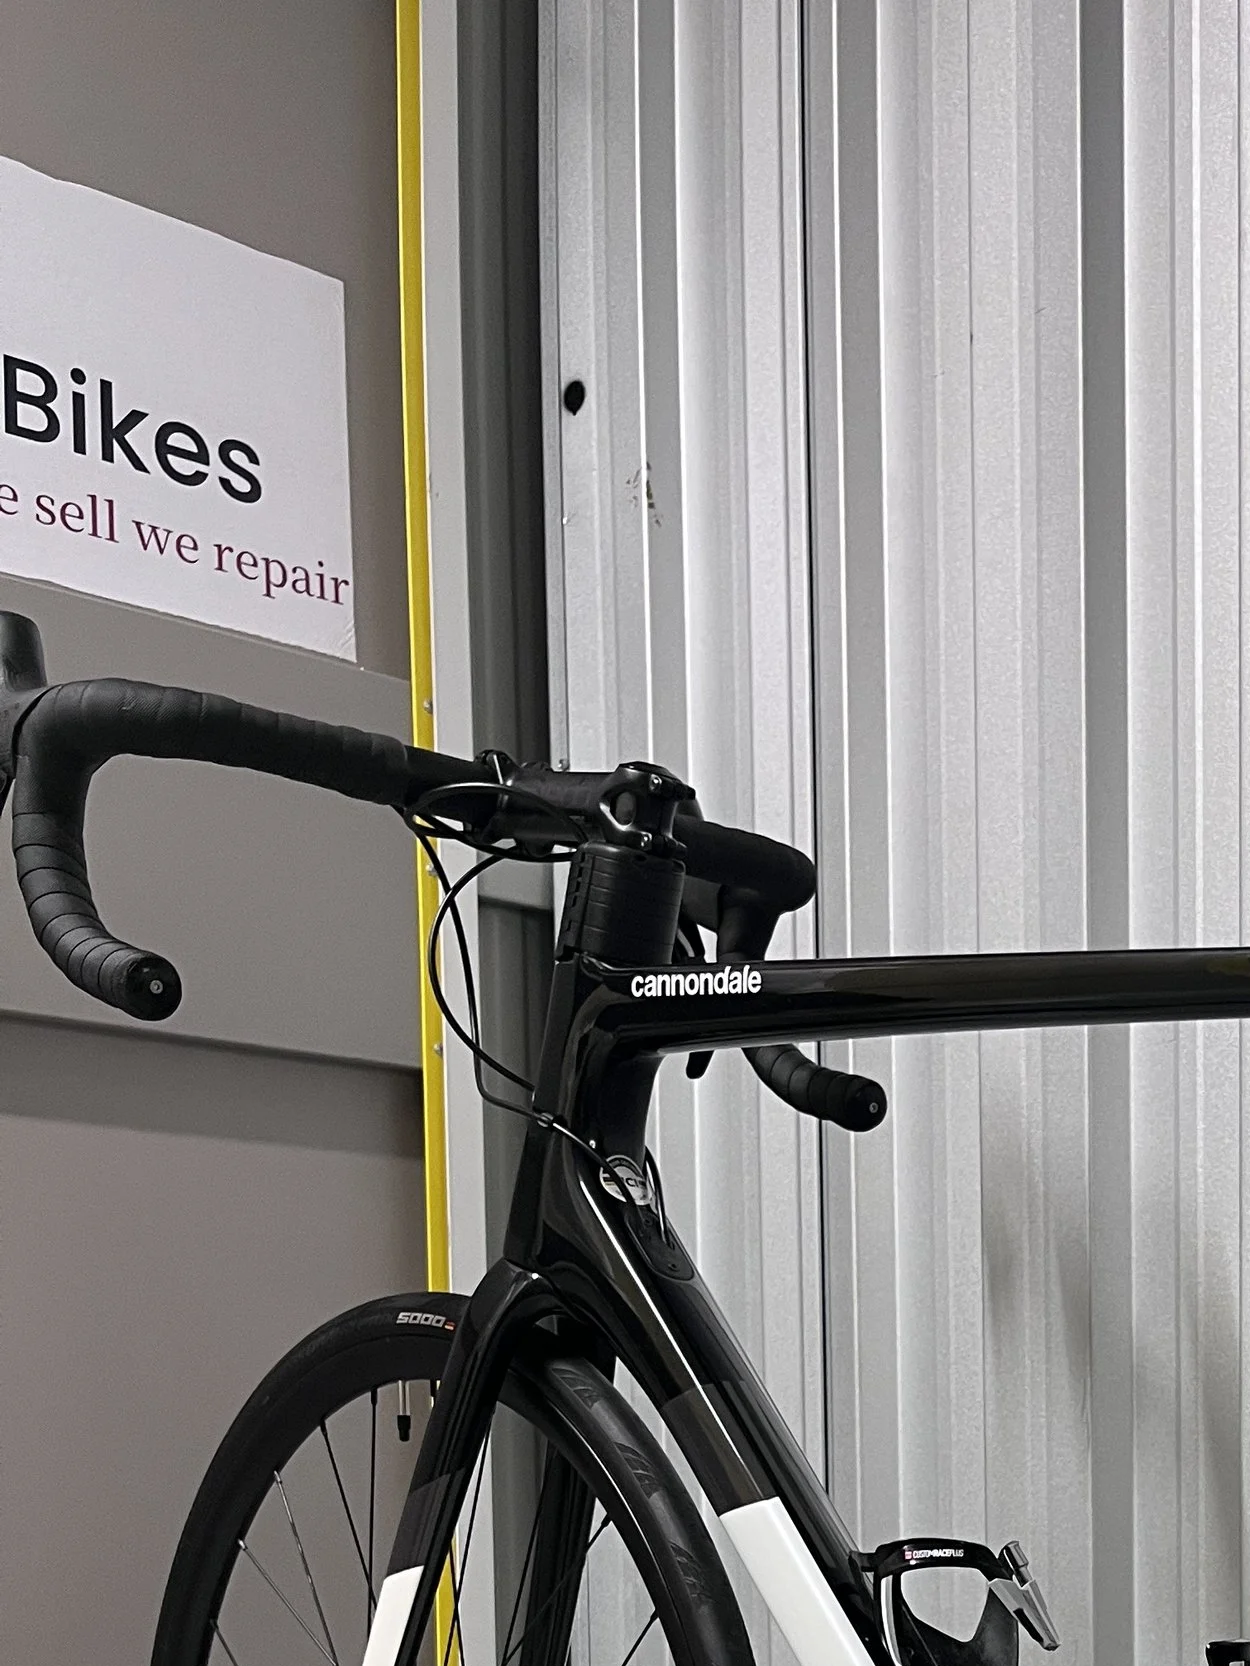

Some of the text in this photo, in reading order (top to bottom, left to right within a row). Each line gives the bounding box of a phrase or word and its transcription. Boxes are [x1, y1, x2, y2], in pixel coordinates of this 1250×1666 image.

[3, 353, 263, 504] Bikes
[0, 484, 350, 606] e sell we repair
[631, 965, 762, 998] cannondale
[396, 1312, 446, 1328] 5000
